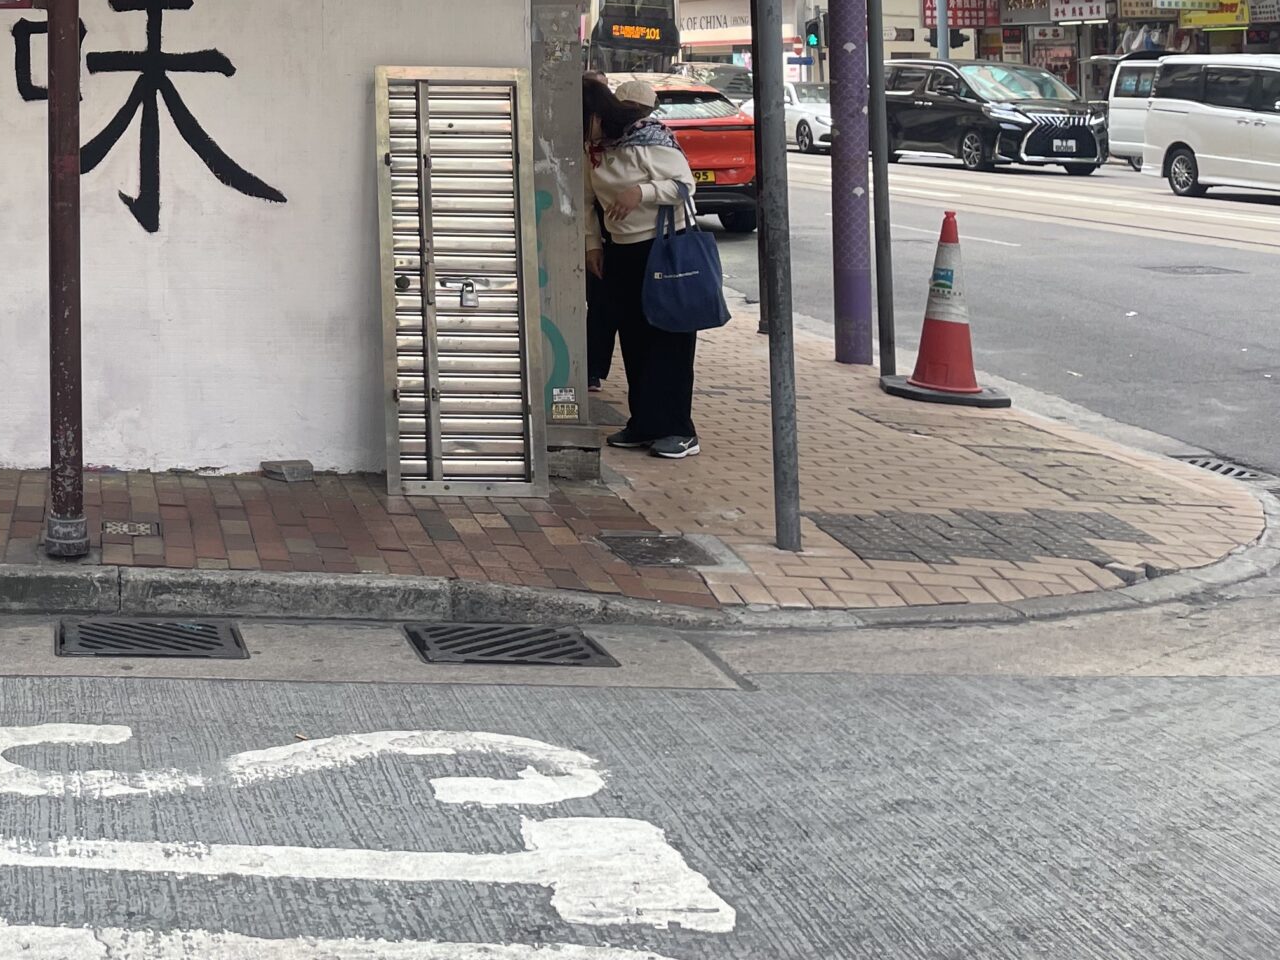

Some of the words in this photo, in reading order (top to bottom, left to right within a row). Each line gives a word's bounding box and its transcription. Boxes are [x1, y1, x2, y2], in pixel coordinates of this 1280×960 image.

[686, 16, 698, 30] OF
[699, 14, 729, 31] CHINA
[645, 27, 661, 40] 101
[693, 171, 709, 181] 95
